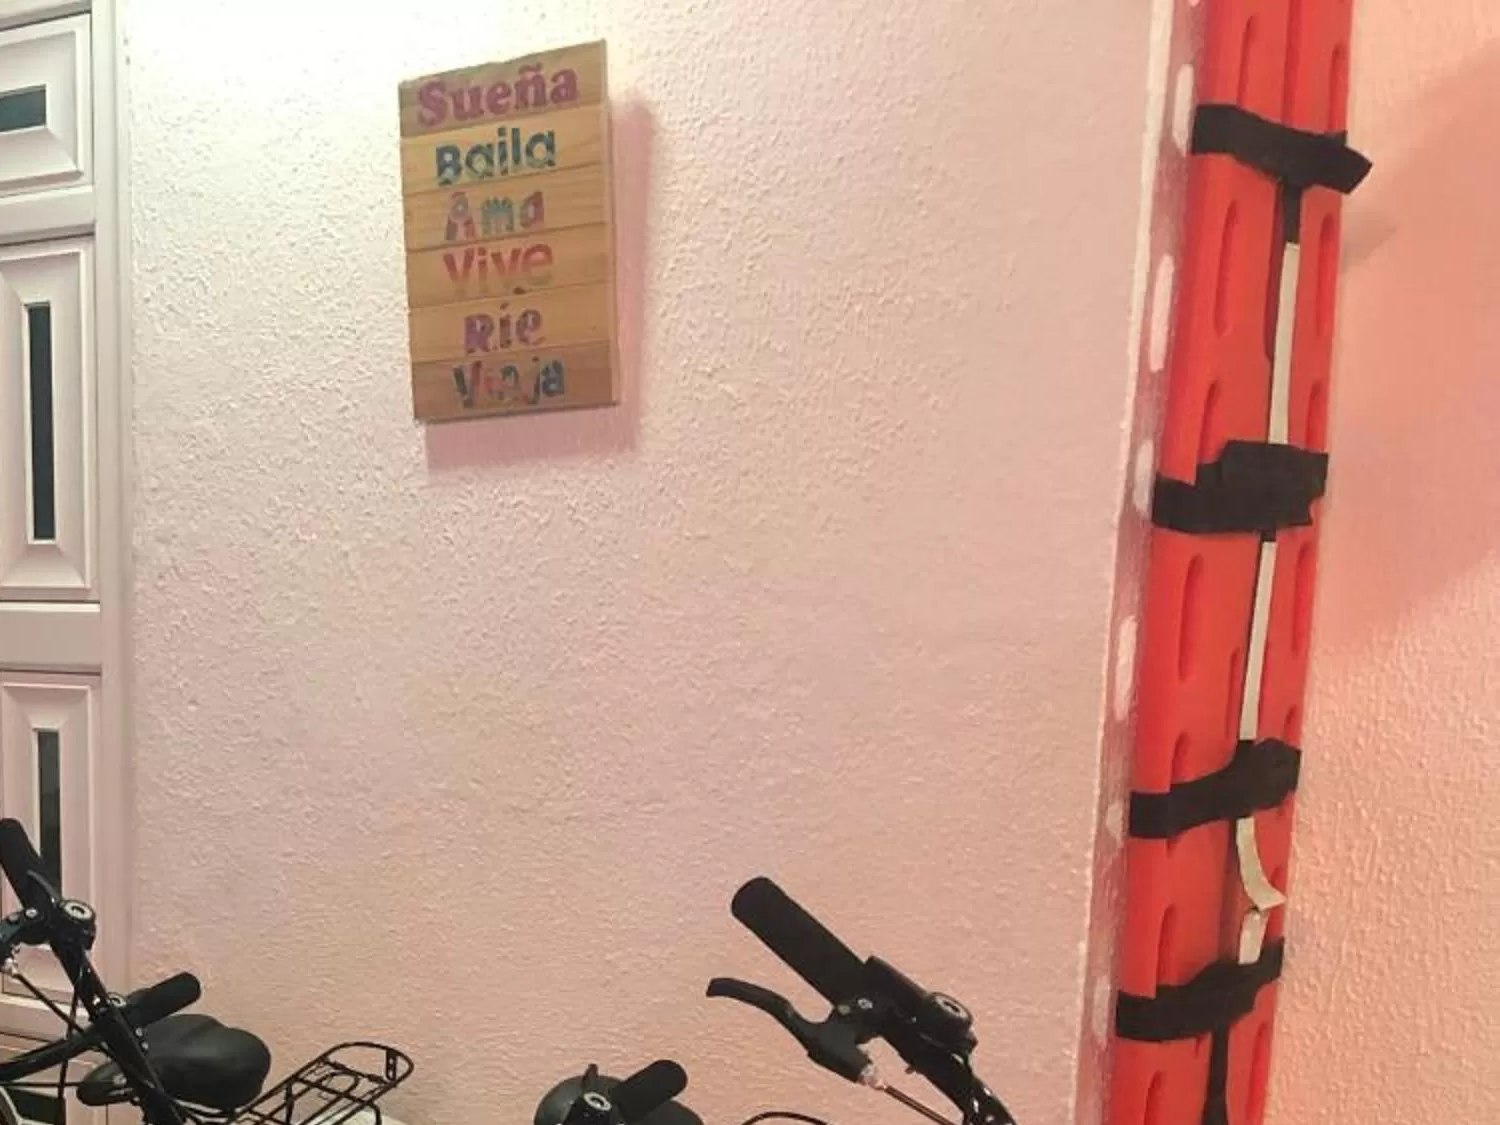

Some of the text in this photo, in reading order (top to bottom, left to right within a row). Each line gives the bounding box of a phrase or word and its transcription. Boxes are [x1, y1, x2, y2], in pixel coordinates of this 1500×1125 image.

[416, 63, 580, 127] Sueña
[435, 127, 557, 186] Baila
[443, 243, 554, 294] Vive
